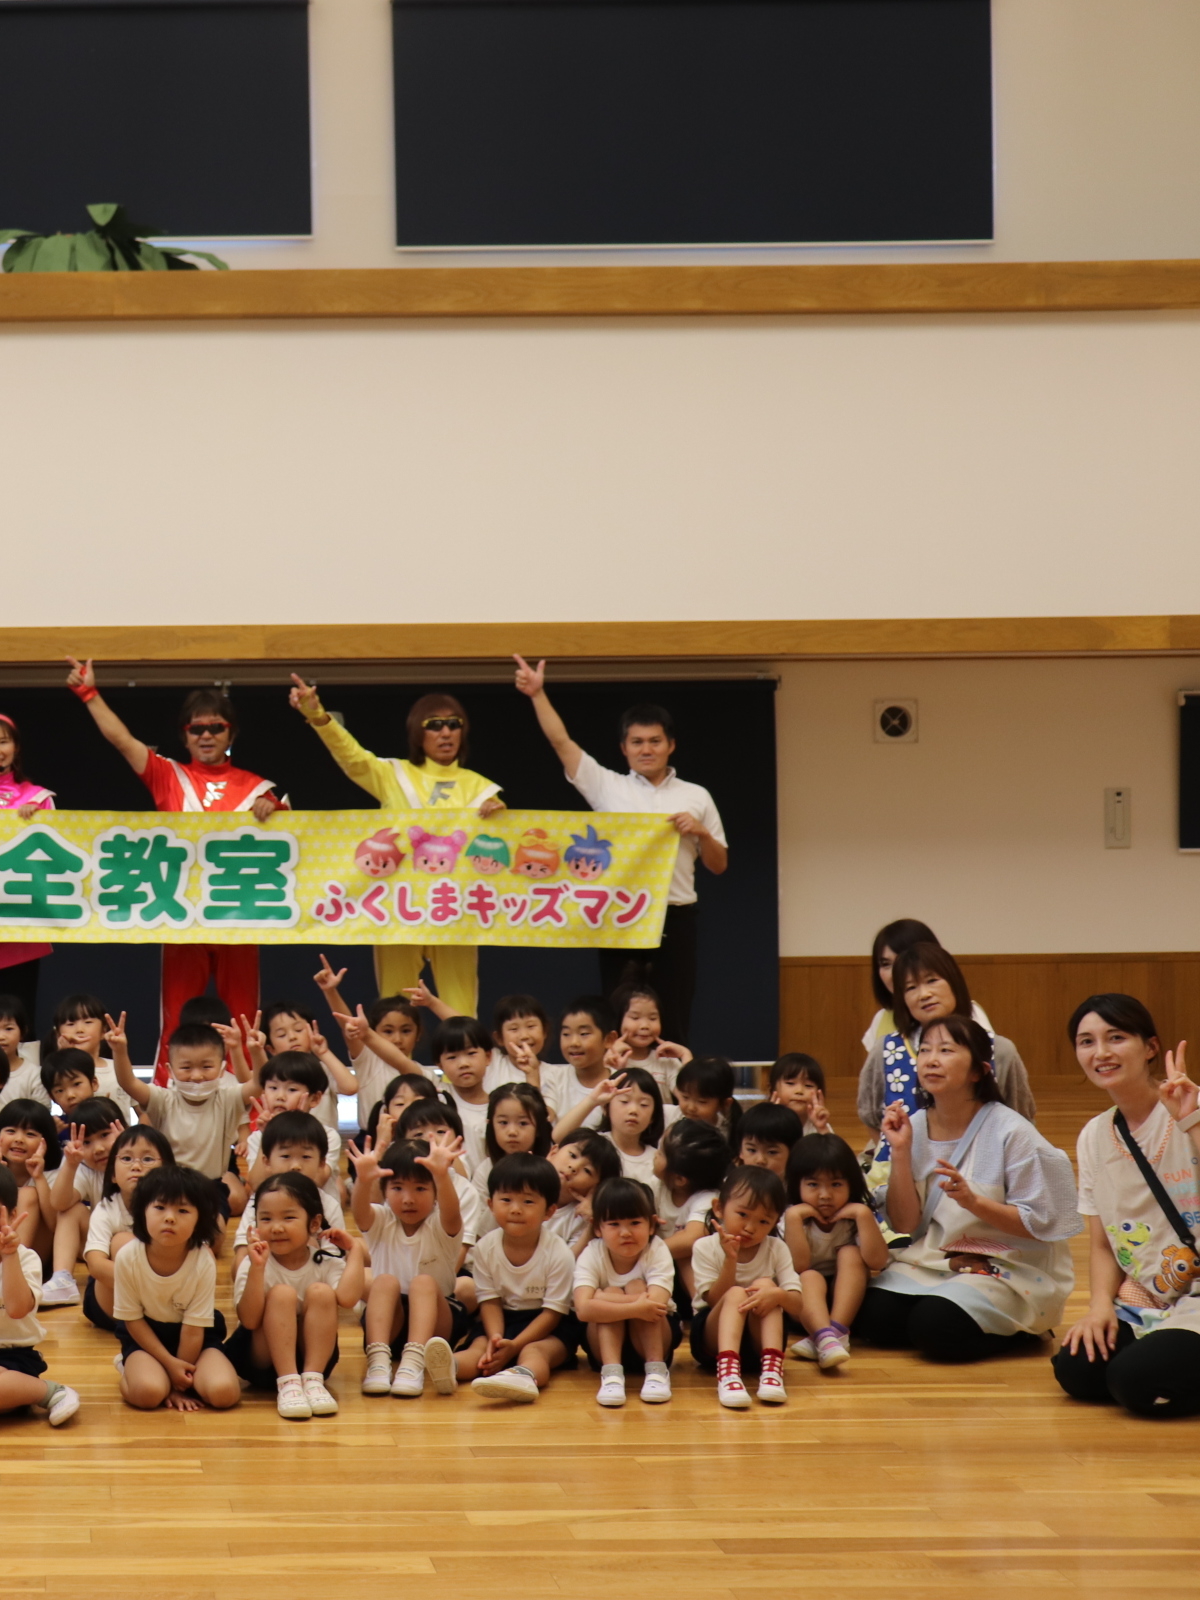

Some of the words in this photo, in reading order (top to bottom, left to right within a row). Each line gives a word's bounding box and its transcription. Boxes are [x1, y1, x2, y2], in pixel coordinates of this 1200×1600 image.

[203, 781, 227, 807] F
[428, 781, 456, 806] F
[315, 882, 648, 924] ふくしまキッズマン
[1163, 1169, 1193, 1183] FUN
